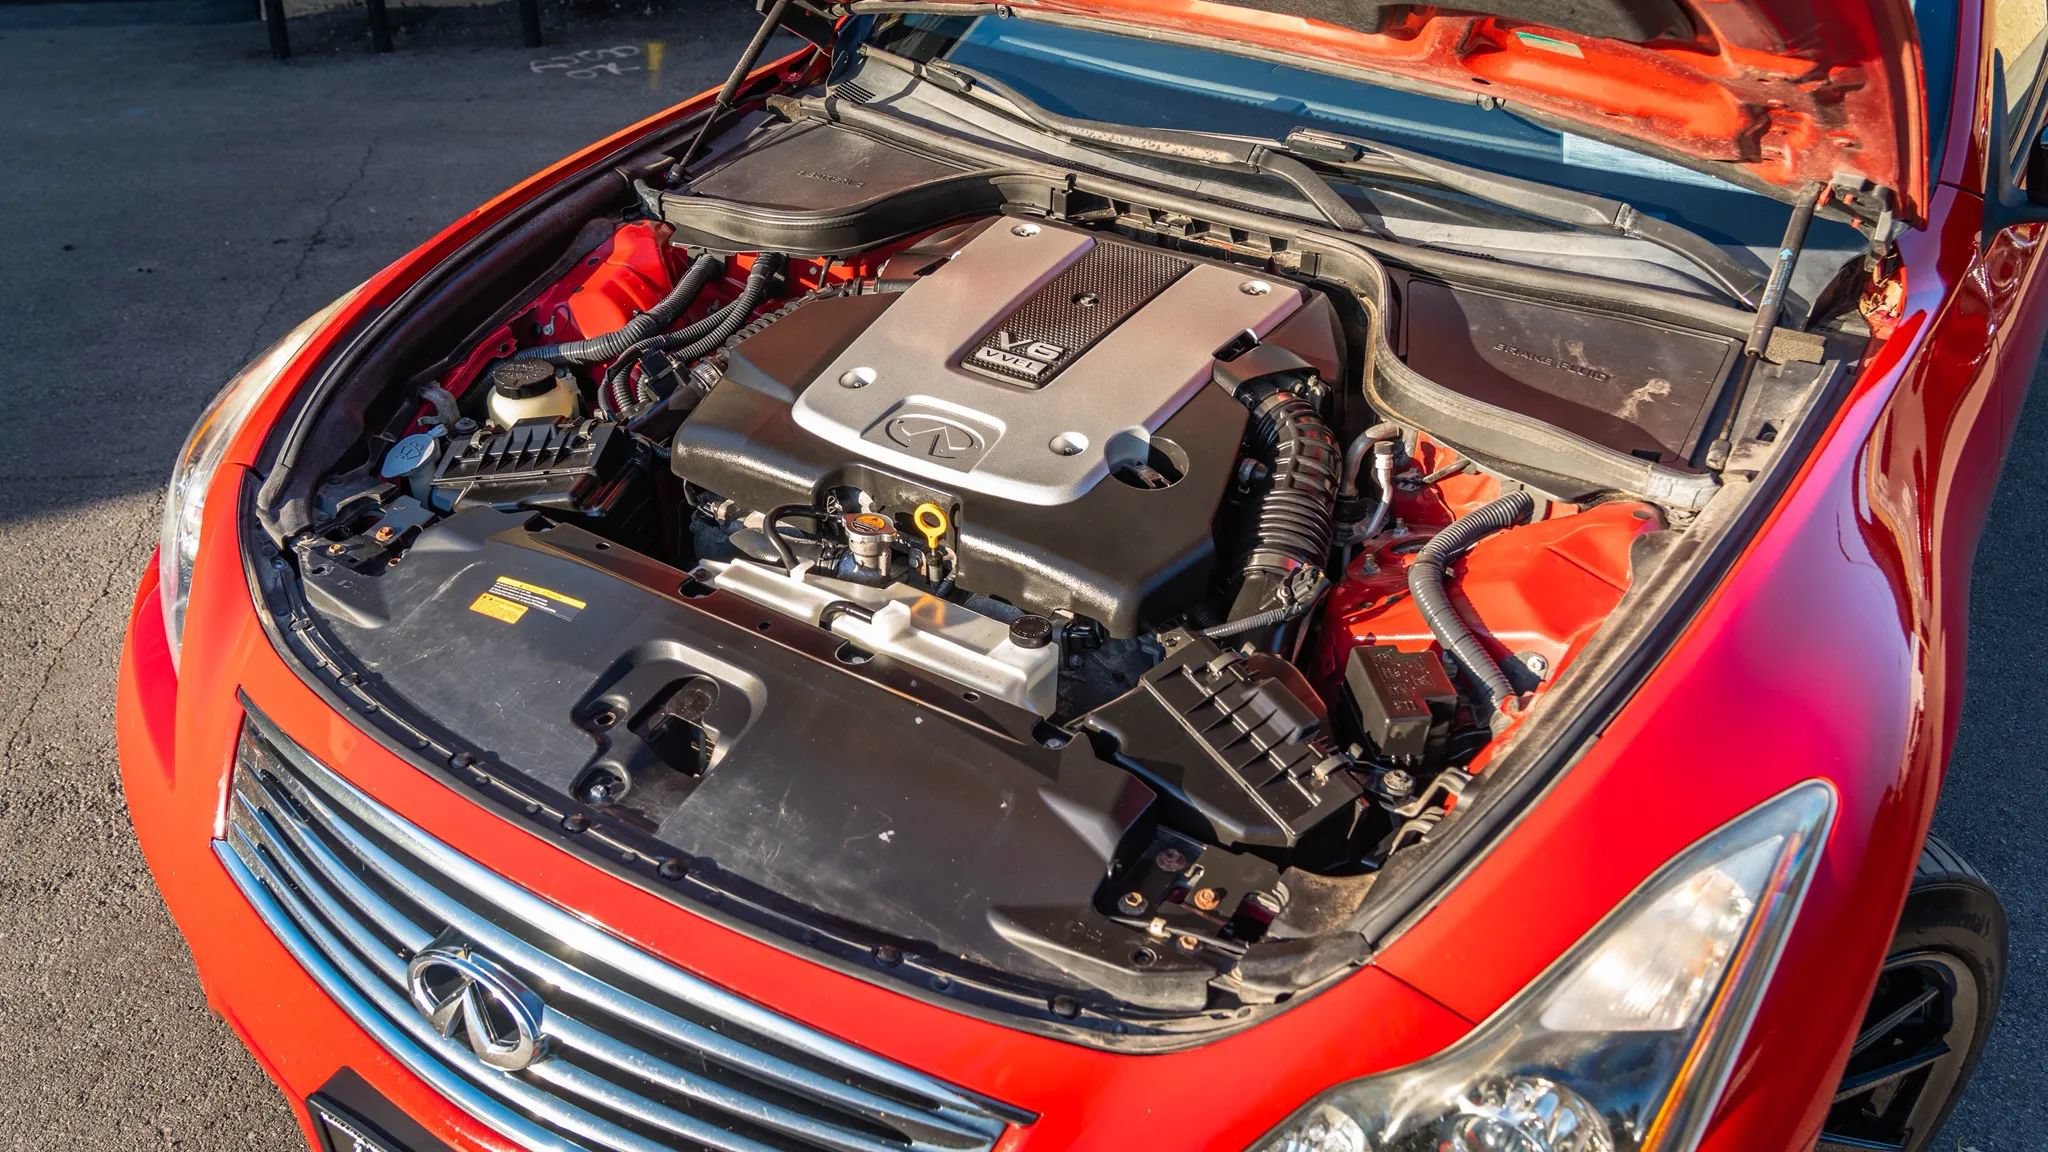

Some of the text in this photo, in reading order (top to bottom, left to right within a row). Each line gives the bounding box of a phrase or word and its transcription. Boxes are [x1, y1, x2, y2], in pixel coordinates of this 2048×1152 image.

[986, 349, 1034, 369] VVEL
[1000, 331, 1064, 361] V6
[1493, 343, 1610, 382] BRAKE FLUID
